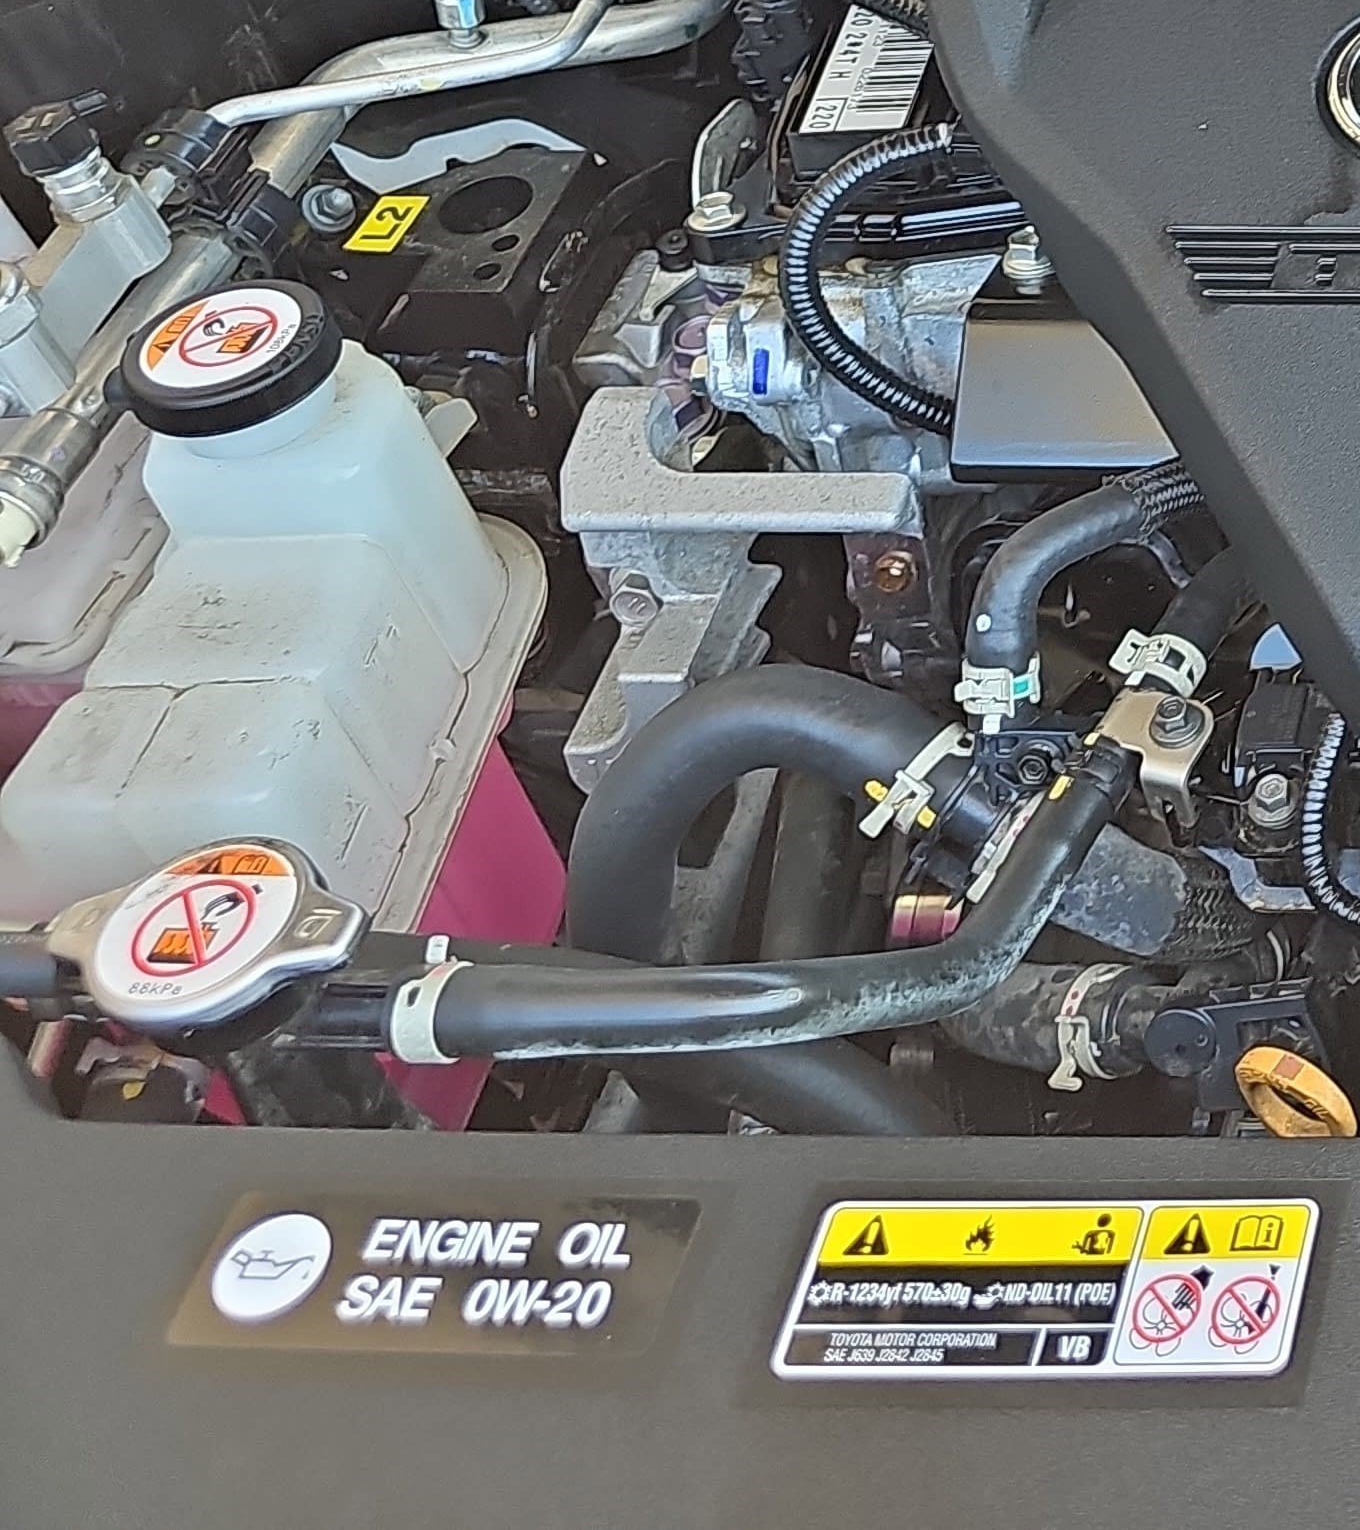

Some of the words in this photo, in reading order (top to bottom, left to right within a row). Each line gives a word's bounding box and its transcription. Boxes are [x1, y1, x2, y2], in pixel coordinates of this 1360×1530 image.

[809, 105, 837, 129] 220
[359, 205, 413, 240] L2
[128, 982, 183, 996] 88kPa
[361, 1219, 540, 1266] ENGINE
[558, 1222, 632, 1270] OIL
[336, 1274, 443, 1325] SAE
[462, 1278, 612, 1328] 0W-20
[830, 1282, 900, 1306] R-1234yf
[903, 1282, 972, 1308] 570±30g
[1073, 1283, 1117, 1307] (POE)
[830, 1332, 873, 1347] TOYOTA
[874, 1332, 915, 1347] MOTOR
[916, 1333, 998, 1349] CORPORATION
[1057, 1335, 1092, 1361] VB
[824, 1349, 846, 1362] SAE
[848, 1349, 875, 1363] J639
